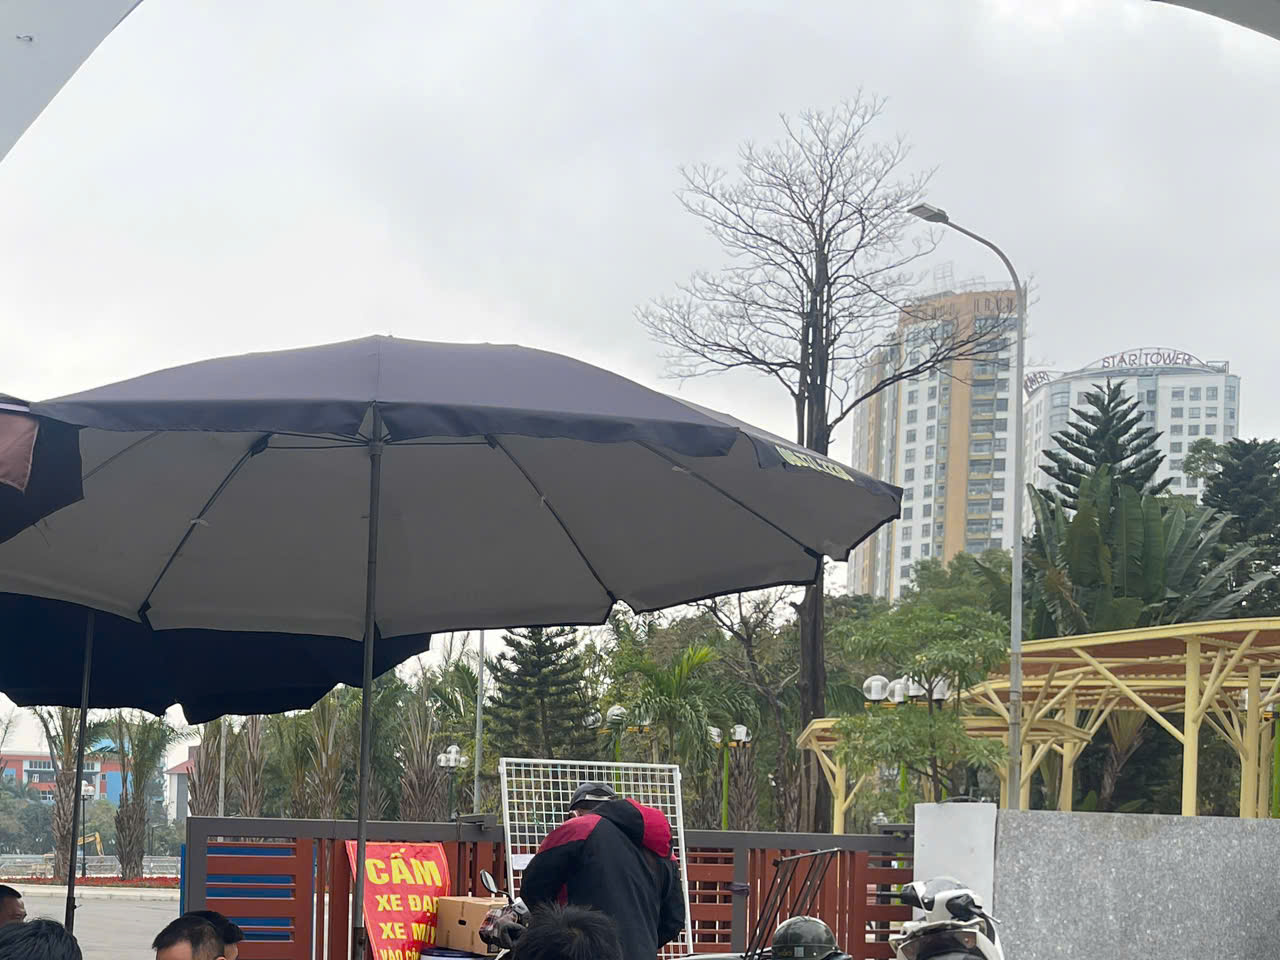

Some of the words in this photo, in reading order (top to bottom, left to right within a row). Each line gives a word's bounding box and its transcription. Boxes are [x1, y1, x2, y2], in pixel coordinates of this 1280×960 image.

[1102, 352, 1138, 368] STAR
[1144, 351, 1193, 367] TOWER
[364, 847, 443, 888] CẤM
[375, 894, 404, 912] XE
[378, 922, 408, 940] XE
